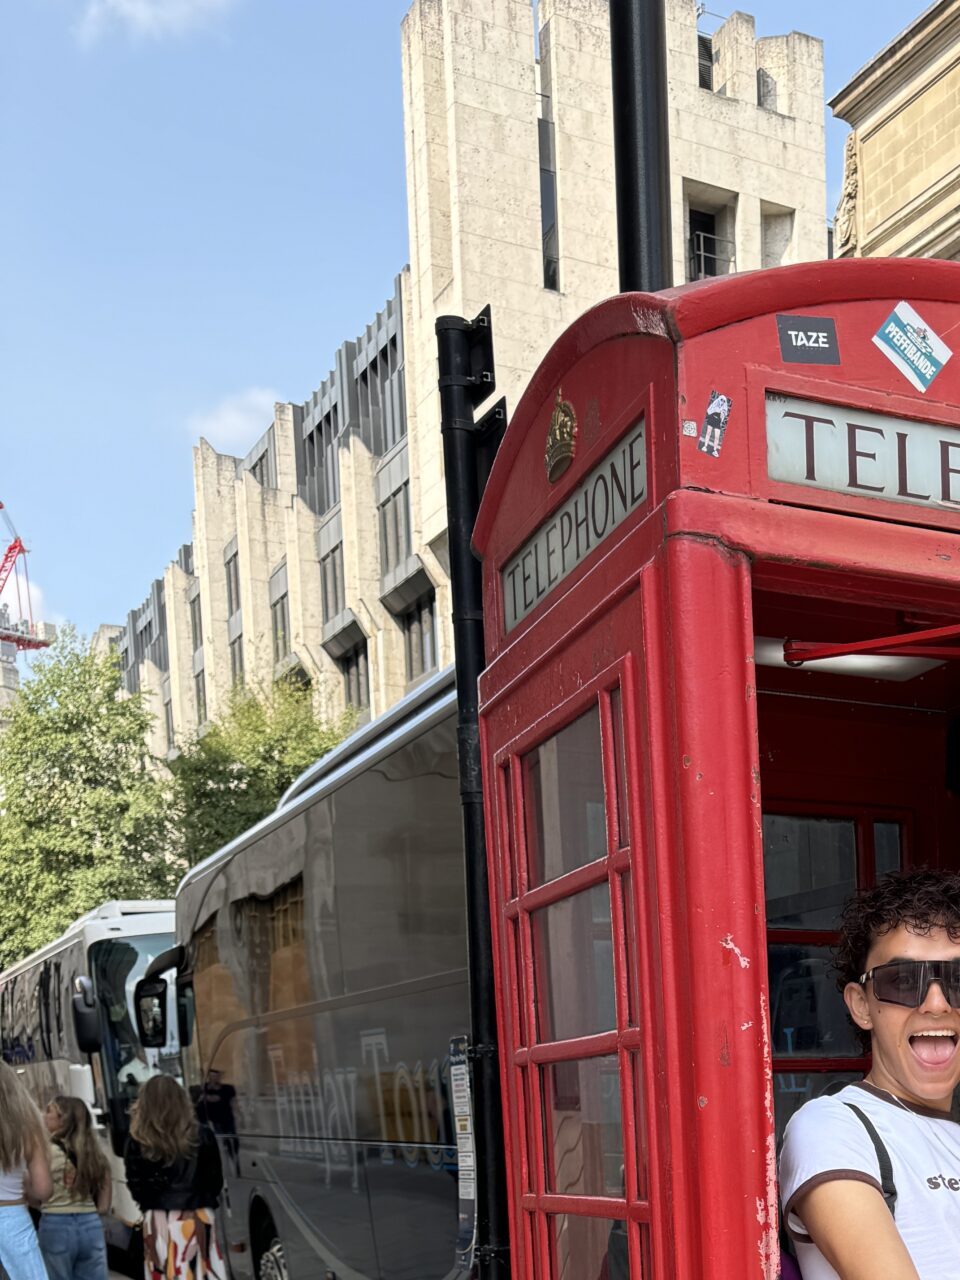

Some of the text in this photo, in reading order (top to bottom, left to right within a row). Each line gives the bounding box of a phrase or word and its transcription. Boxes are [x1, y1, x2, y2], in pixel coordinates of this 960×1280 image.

[788, 330, 830, 348] TAZE
[885, 322, 937, 380] PFEFFIBANDE
[507, 431, 645, 621] TELEPHONE
